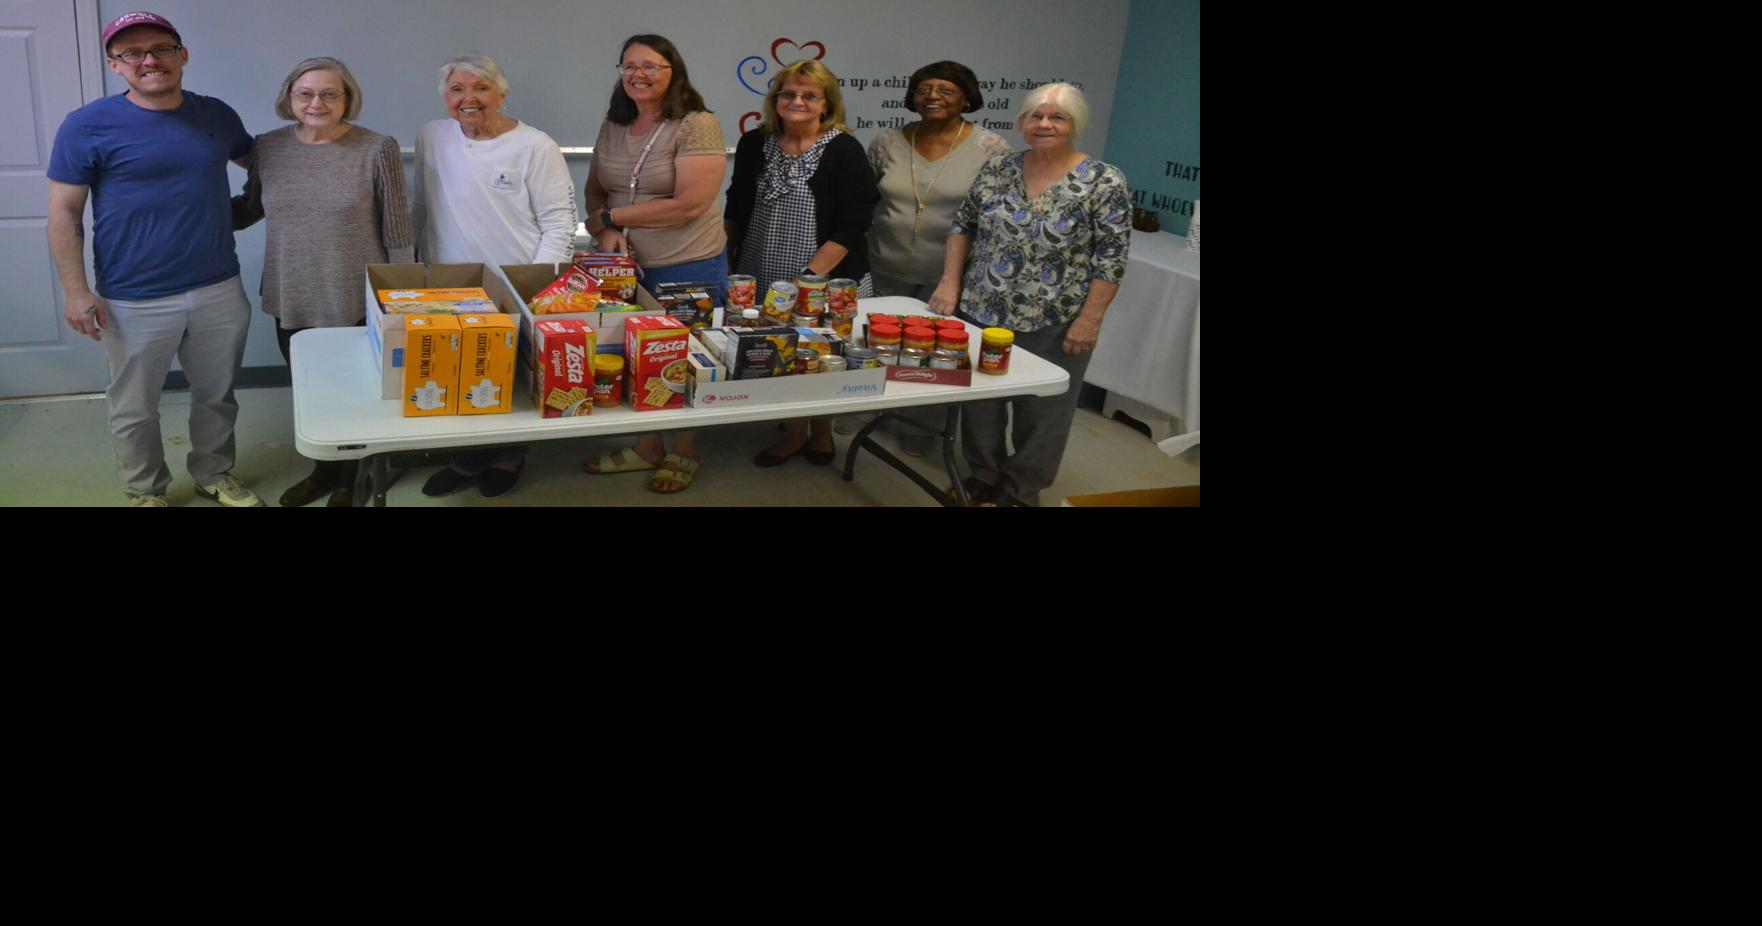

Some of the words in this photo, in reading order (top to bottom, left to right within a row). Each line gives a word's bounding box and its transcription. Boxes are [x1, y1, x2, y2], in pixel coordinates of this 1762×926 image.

[850, 78, 868, 91] up
[872, 79, 881, 88] a
[884, 76, 912, 88] chil
[977, 81, 996, 92] ay
[1000, 78, 1016, 89] he
[988, 98, 1009, 109] old
[857, 117, 873, 129] he
[877, 117, 905, 129] will
[982, 118, 1013, 130] from
[1166, 161, 1200, 181] THAT
[1131, 189, 1148, 205] AT
[588, 267, 635, 277] HELPER
[421, 335, 432, 359] CRACKERS
[477, 333, 487, 356] CRACKERS
[642, 340, 687, 356] Zesta
[475, 356, 486, 377] SALTINE
[551, 349, 563, 377] Original
[565, 342, 585, 384] Zesta
[649, 353, 678, 364] Original
[420, 359, 431, 378] SALTINE
[841, 384, 877, 393] Vitality
[719, 394, 749, 402] xerox
